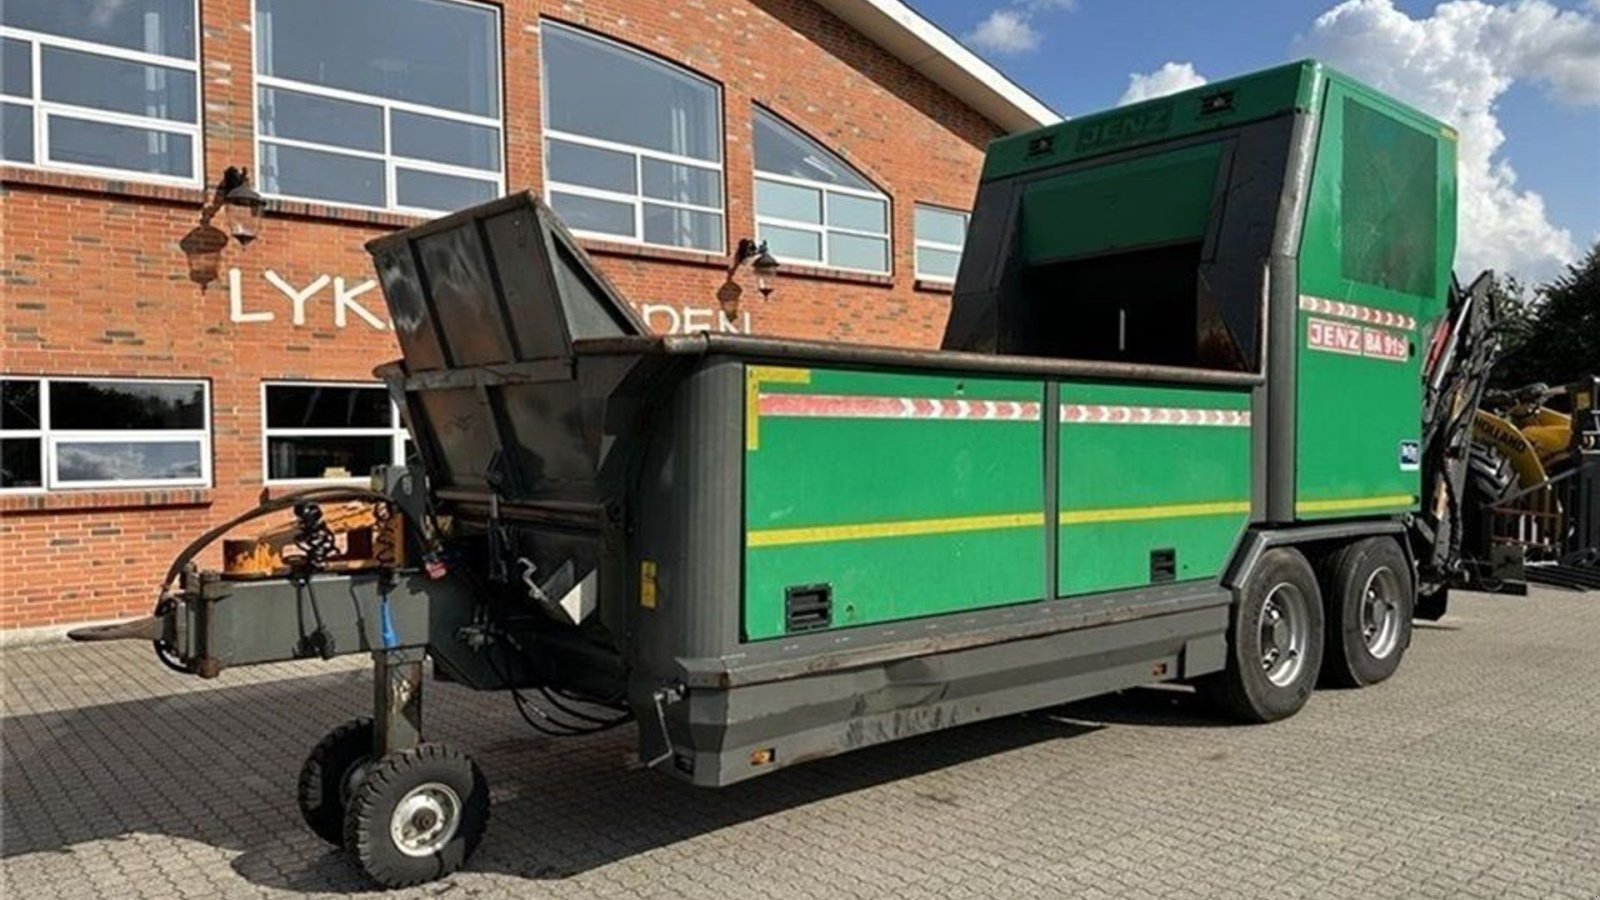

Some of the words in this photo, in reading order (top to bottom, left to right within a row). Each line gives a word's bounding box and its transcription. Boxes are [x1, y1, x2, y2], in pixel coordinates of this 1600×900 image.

[1081, 107, 1168, 144] JENZ
[229, 268, 395, 330] LYK
[630, 301, 750, 335] DEN
[1310, 324, 1360, 350] JENZ
[1364, 332, 1382, 353] BA
[1474, 414, 1525, 451] HOLLAND
